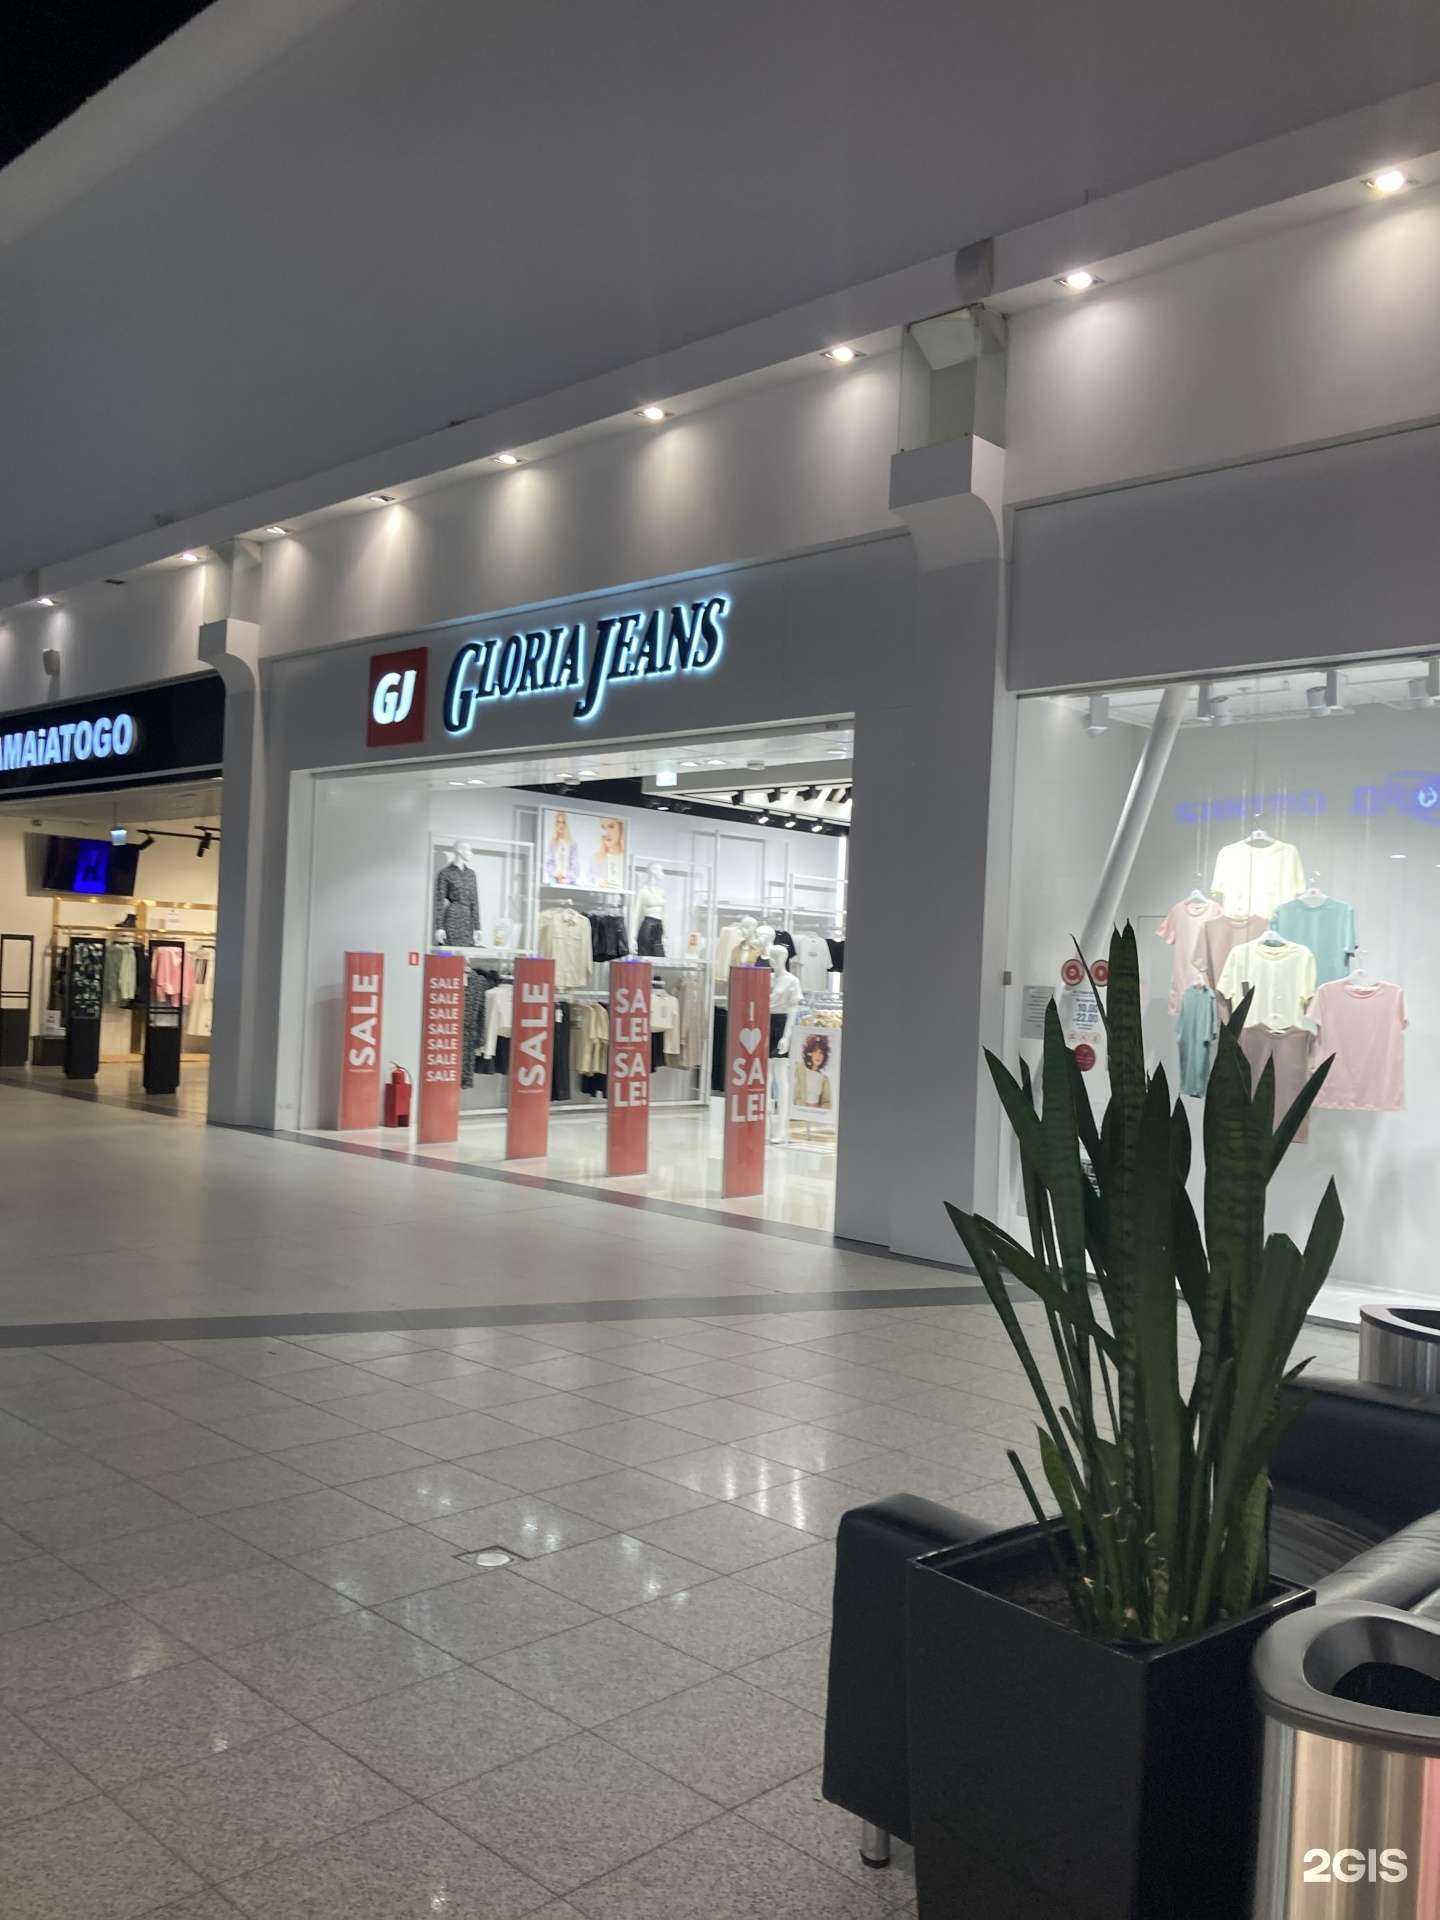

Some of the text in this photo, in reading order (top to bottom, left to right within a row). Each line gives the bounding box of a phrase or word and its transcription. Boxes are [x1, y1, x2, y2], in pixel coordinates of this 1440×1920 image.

[444, 596, 732, 733] GLORIA JEANS
[372, 669, 417, 724] GJ
[0, 713, 133, 771] MAiATOGO
[430, 977, 460, 989] SALE
[429, 992, 459, 1005] SALE
[614, 987, 648, 1014] SA
[349, 974, 379, 1067] SALE
[428, 1008, 459, 1020] SALE
[428, 1023, 458, 1035] SALE
[517, 983, 549, 1087] SALE
[614, 1017, 649, 1043] LE!
[427, 1038, 458, 1050] SALE
[427, 1053, 457, 1065] SALE
[614, 1053, 647, 1078] SA
[731, 1057, 765, 1087] SA
[426, 1069, 456, 1082] SALE
[613, 1081, 648, 1108] LE!
[731, 1093, 767, 1123] LE!
